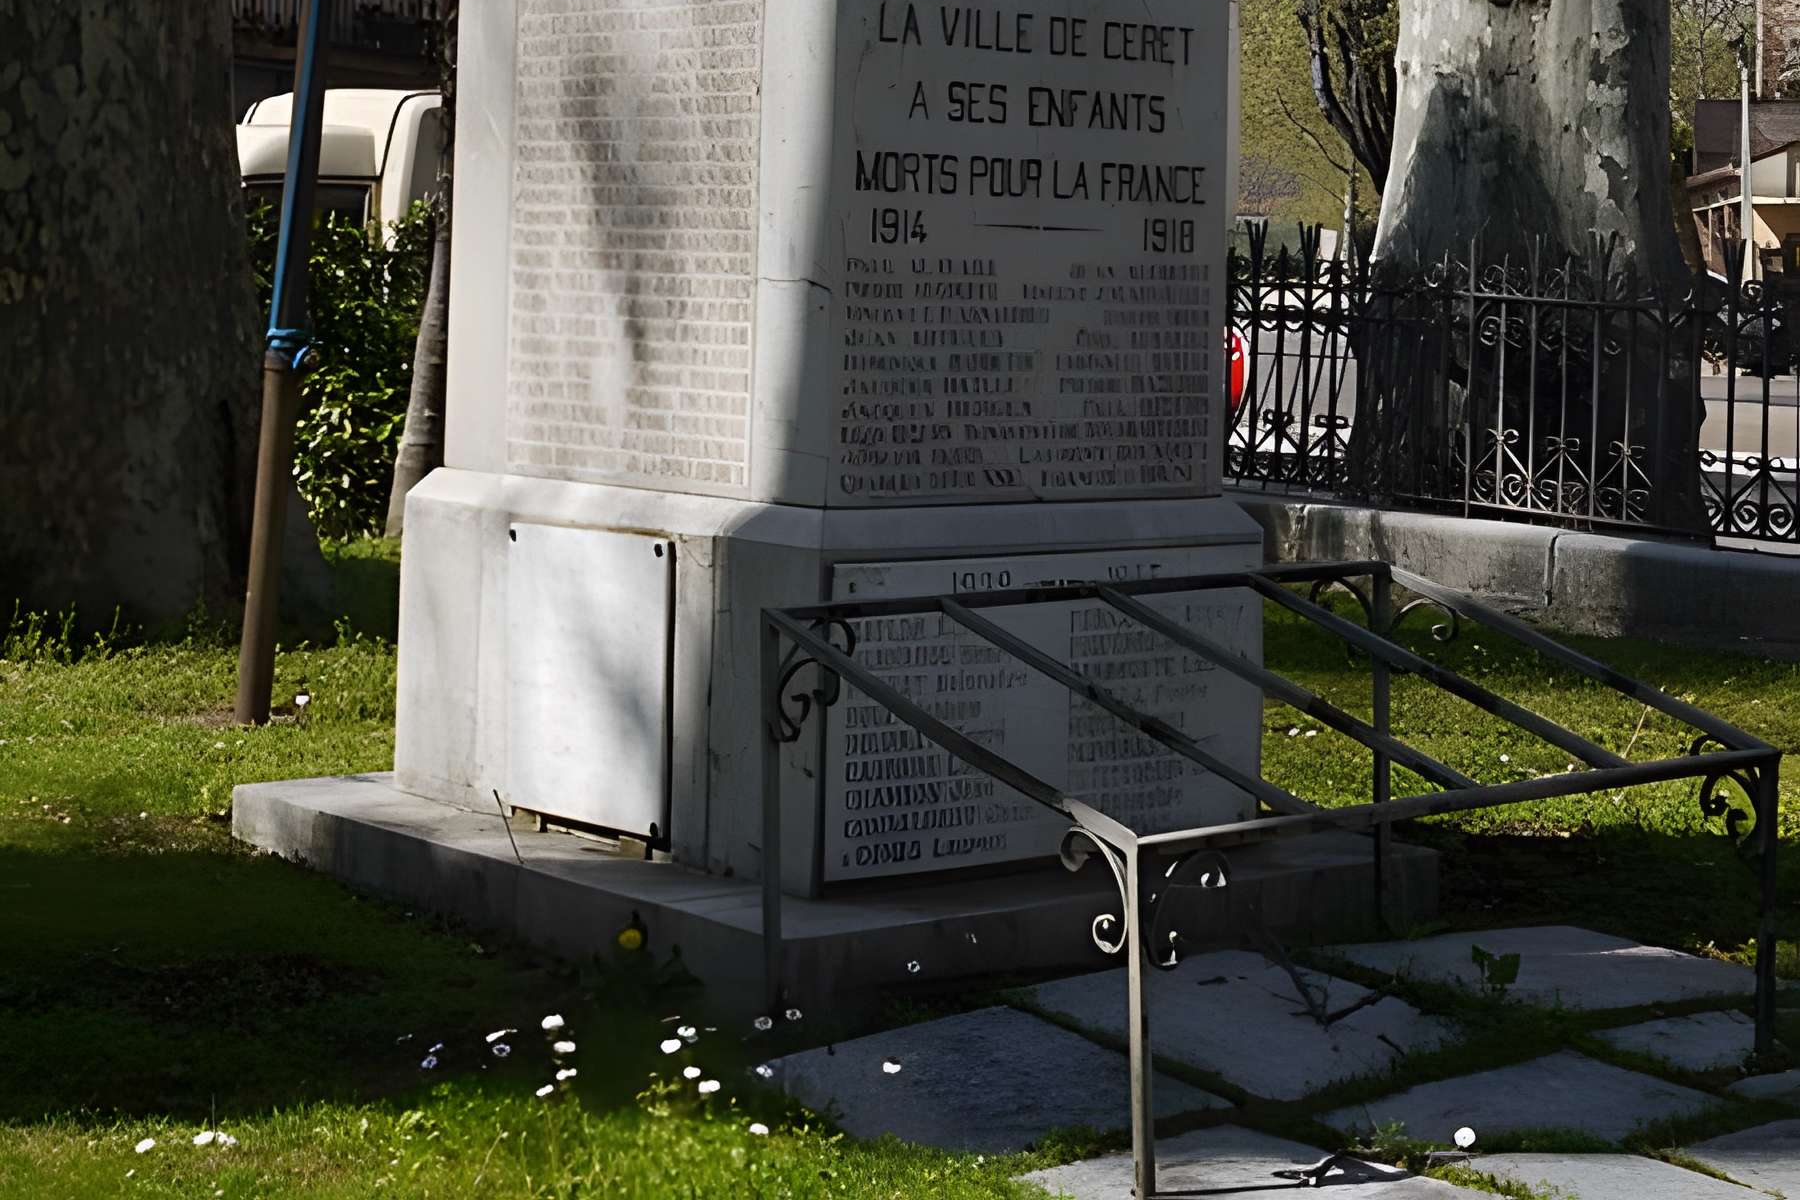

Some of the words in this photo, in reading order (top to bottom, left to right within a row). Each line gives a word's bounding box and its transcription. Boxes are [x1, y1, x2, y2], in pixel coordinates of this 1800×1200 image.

[878, 0, 922, 46] LA
[940, 6, 1033, 54] VILLE
[1049, 16, 1087, 58] DE
[1103, 21, 1195, 66] CERET
[908, 80, 929, 120] A
[947, 81, 1008, 125] SES
[1028, 86, 1166, 133] ENFANTS
[855, 150, 958, 195] MORTS
[969, 155, 1042, 198] POUR
[1053, 160, 1089, 200] LA
[1100, 162, 1206, 205] FRANCE
[871, 208, 928, 244] 1914
[1143, 218, 1195, 254] 1918
